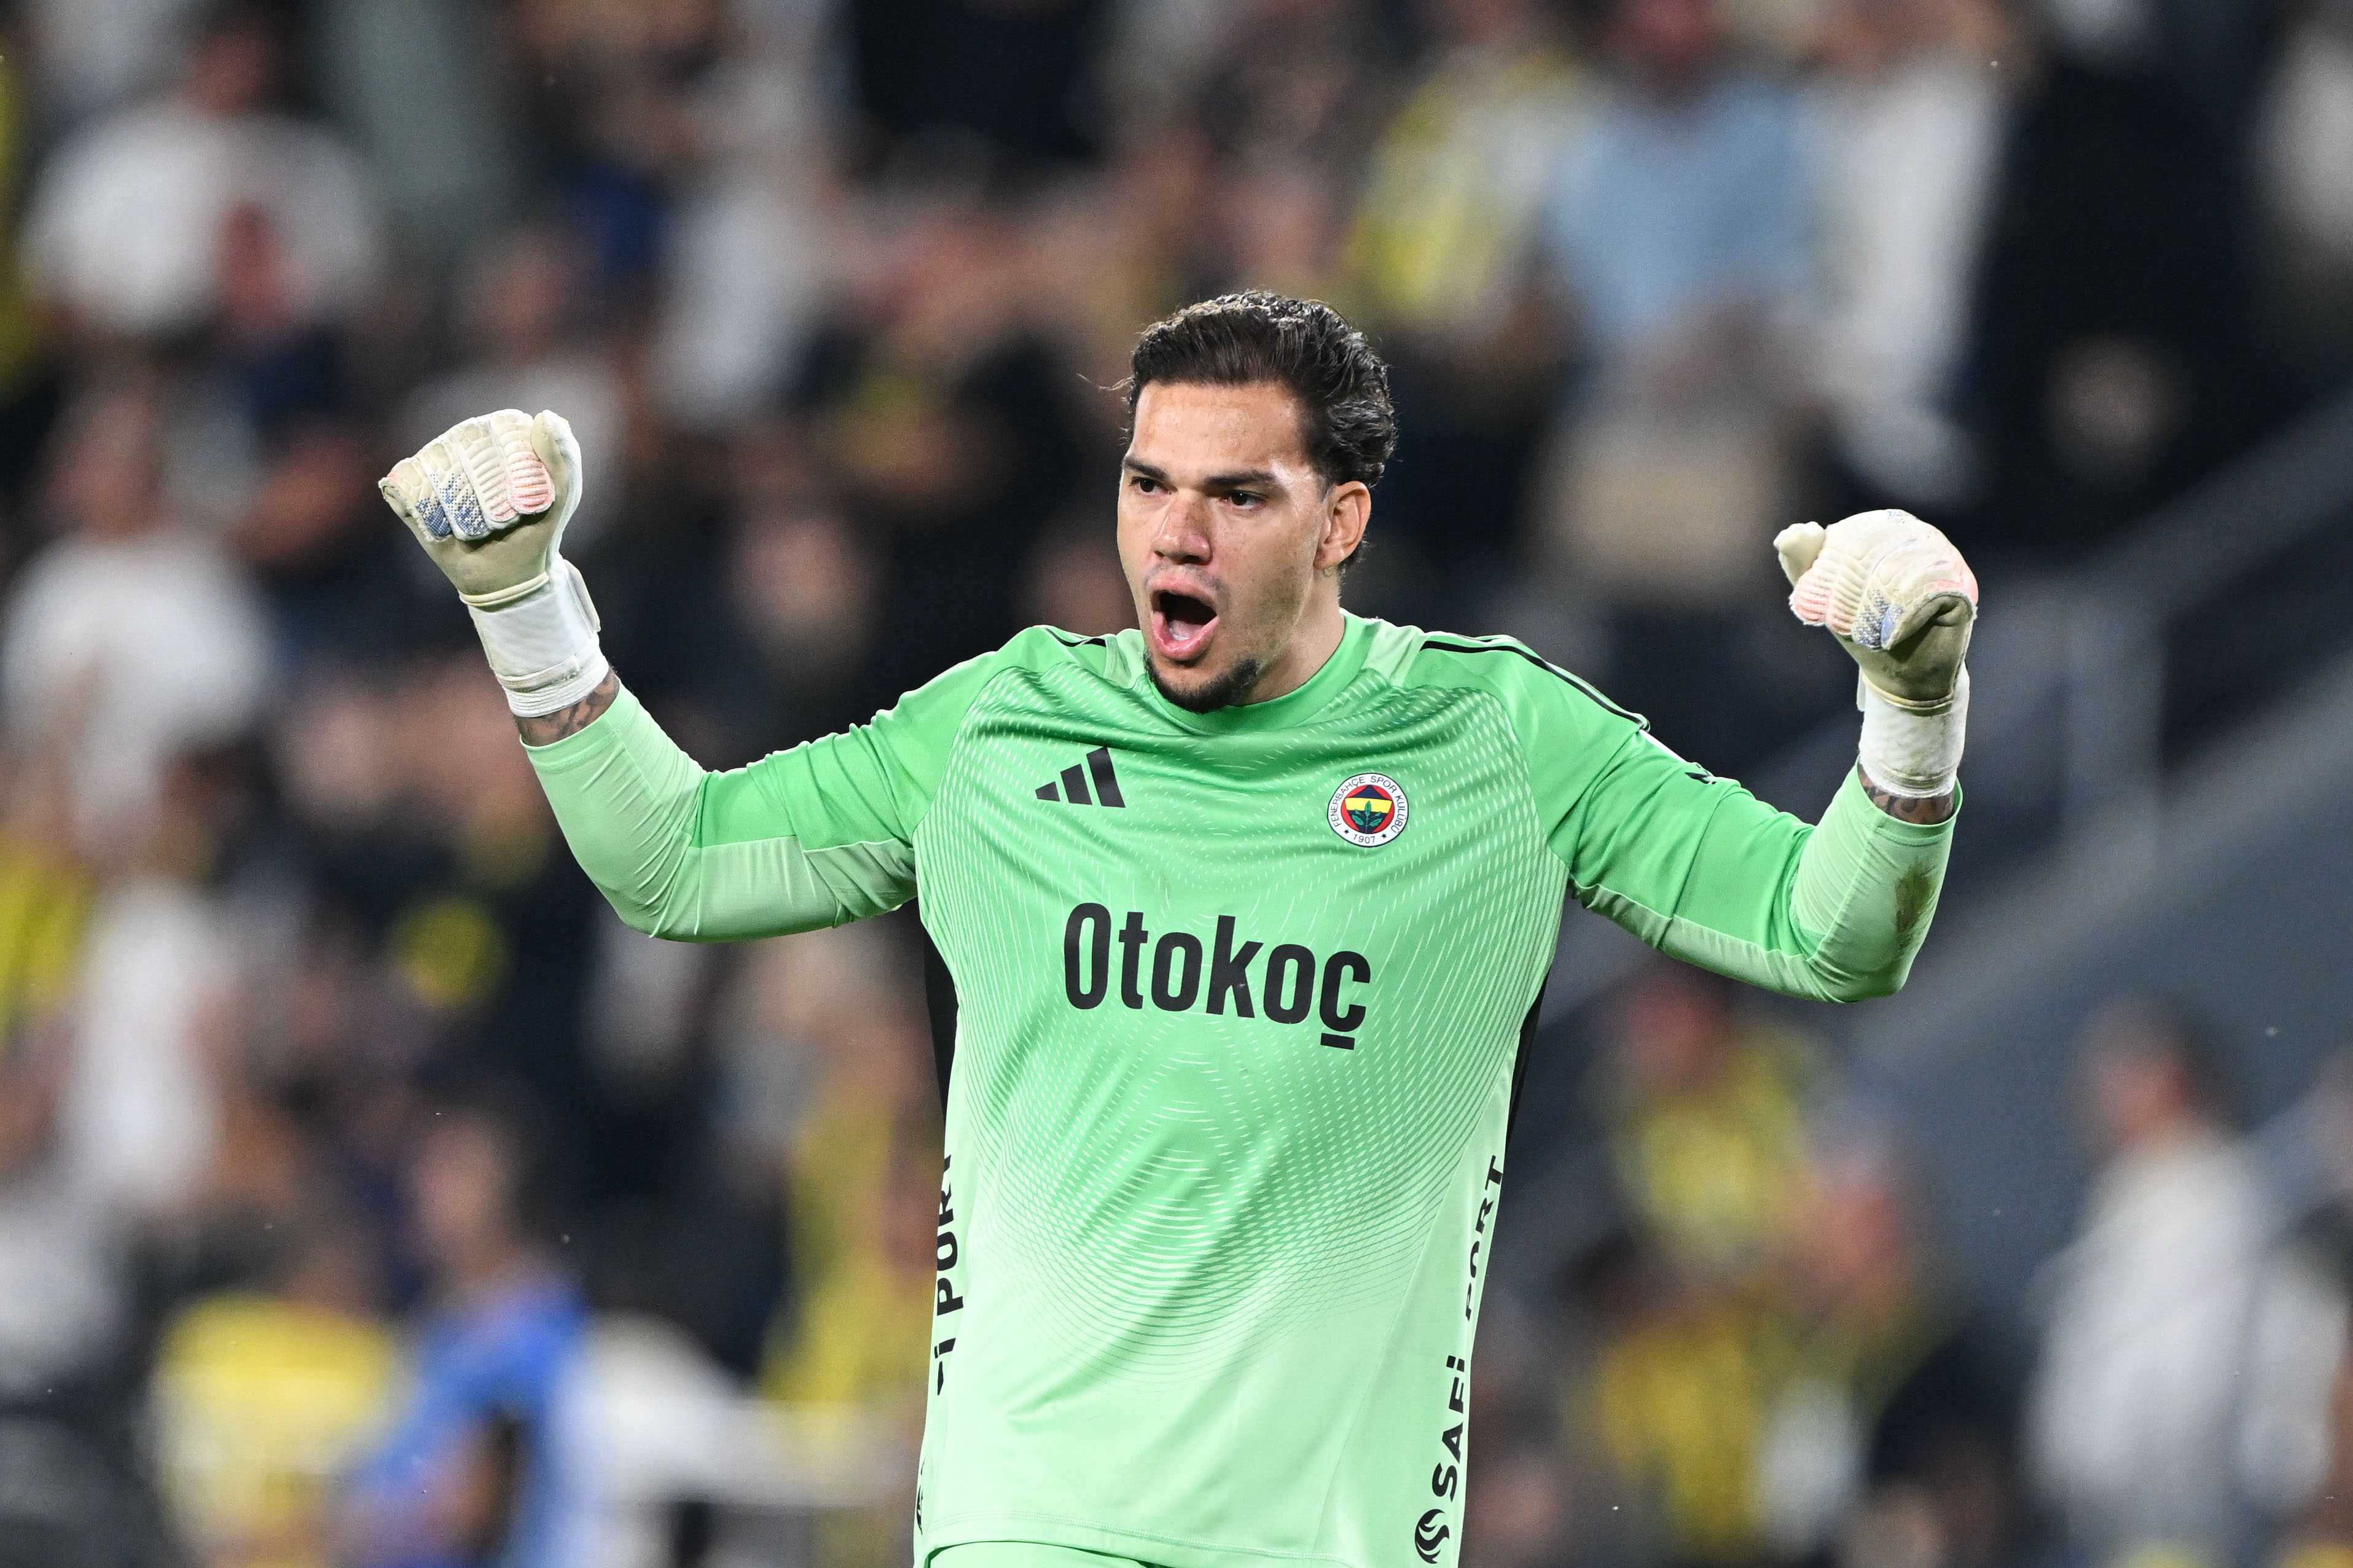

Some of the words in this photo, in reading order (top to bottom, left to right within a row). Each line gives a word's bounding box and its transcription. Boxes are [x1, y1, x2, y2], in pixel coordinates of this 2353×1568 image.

[1331, 776, 1365, 827] FENERBAHÇE
[1370, 776, 1396, 793] SPOR
[1353, 834, 1376, 844] 1907
[1063, 902, 1371, 1050] Otokoç
